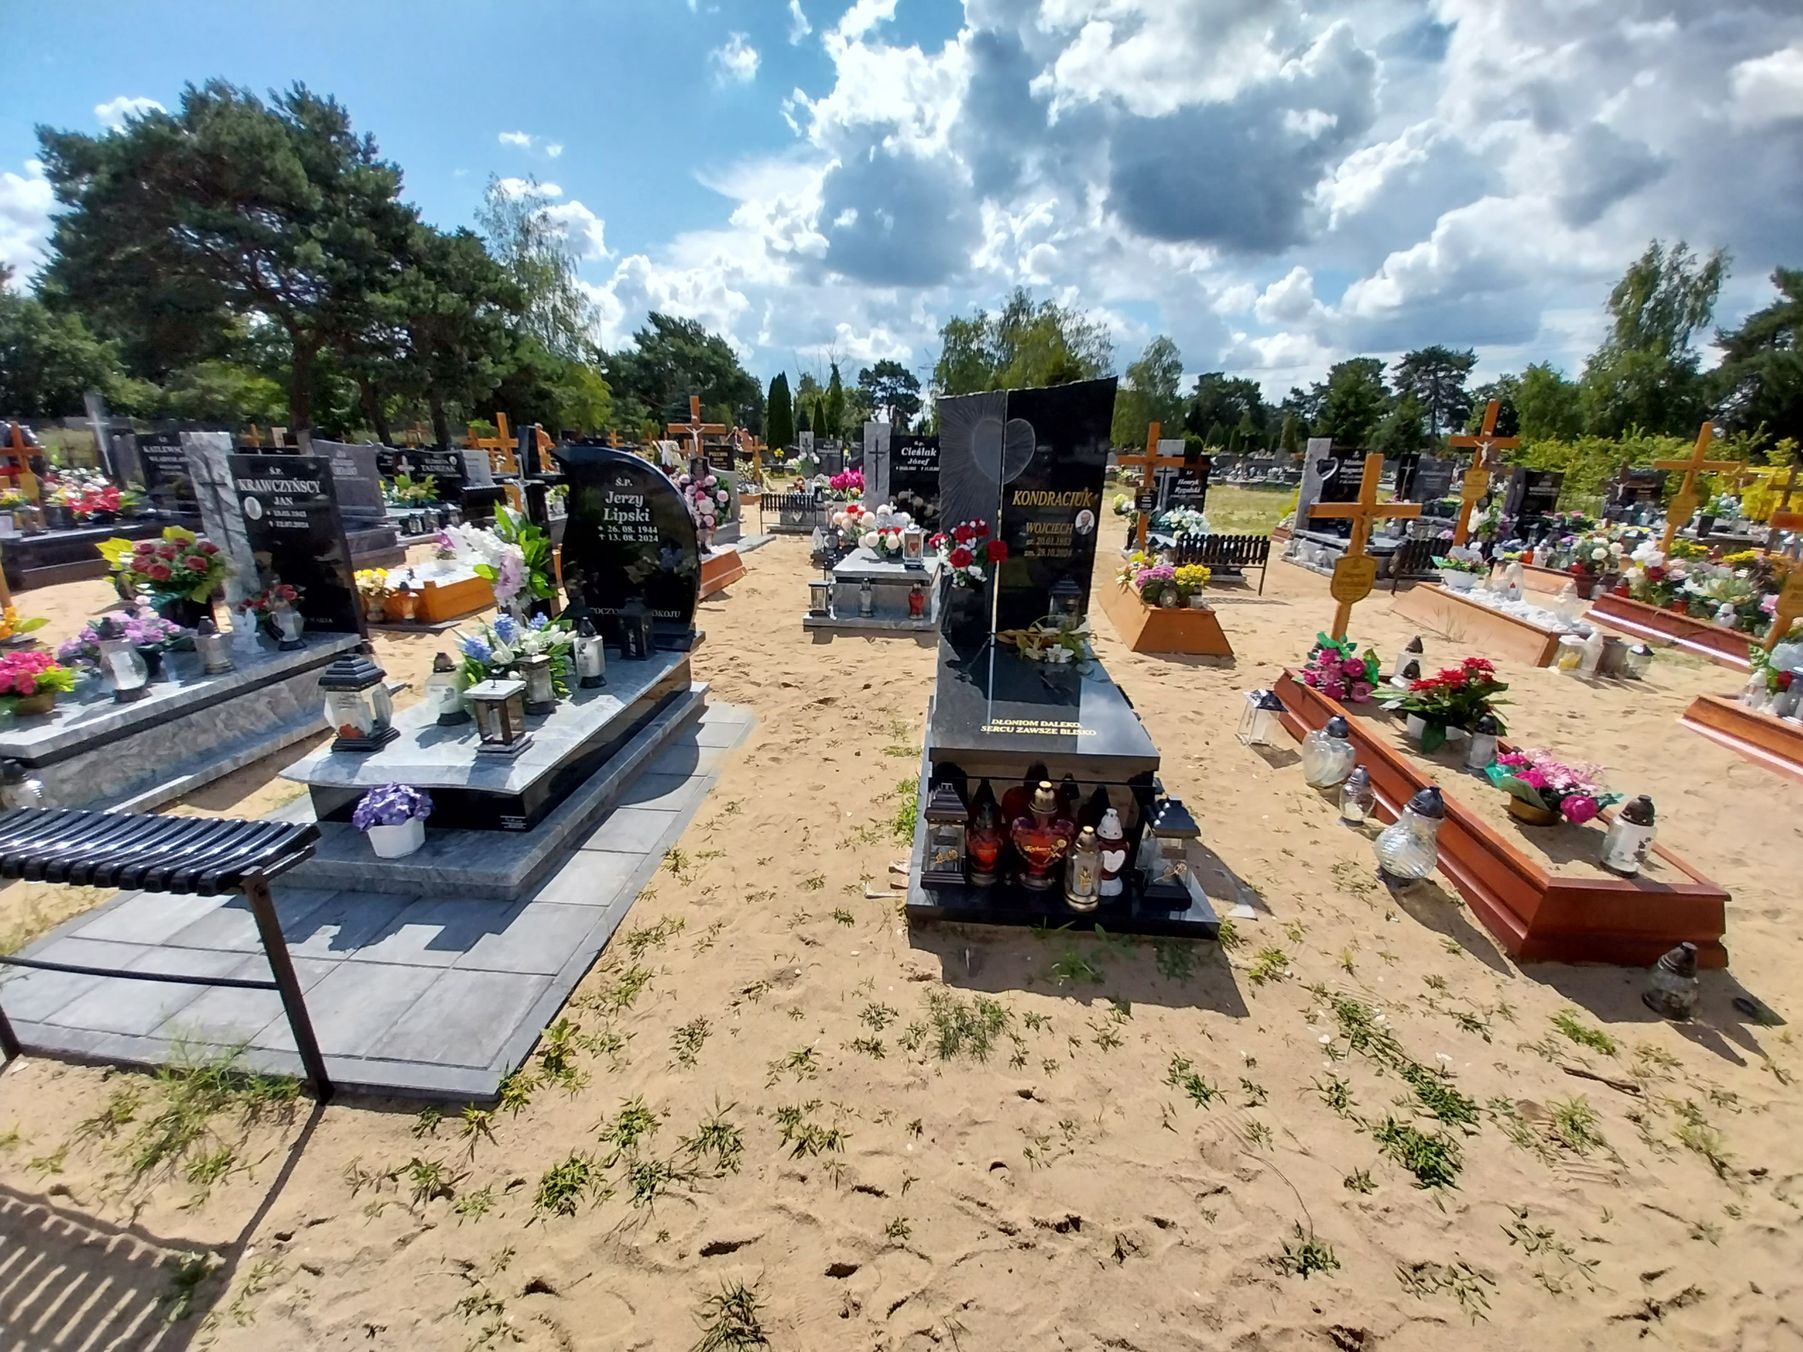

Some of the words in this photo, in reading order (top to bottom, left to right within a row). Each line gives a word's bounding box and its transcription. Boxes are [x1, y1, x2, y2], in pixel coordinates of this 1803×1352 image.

[901, 447, 937, 456] Cieślak
[237, 477, 321, 493] KRAWCZYŃSCY
[274, 496, 294, 506] JAN
[605, 490, 644, 508] Jerzy
[1012, 490, 1093, 507] KONDRACIUK
[604, 507, 650, 524] Lipski
[608, 525, 621, 533] 26.
[622, 525, 636, 533] 08.
[637, 526, 658, 534] 1944
[1025, 521, 1075, 535] WOJCIECH
[622, 534, 636, 542] 08.
[638, 534, 659, 543] 2024
[652, 609, 682, 618] OKOJU
[980, 725, 1015, 734] SERCU
[1015, 726, 1059, 735] ZAWSZE
[1059, 729, 1097, 737] BLISKO
